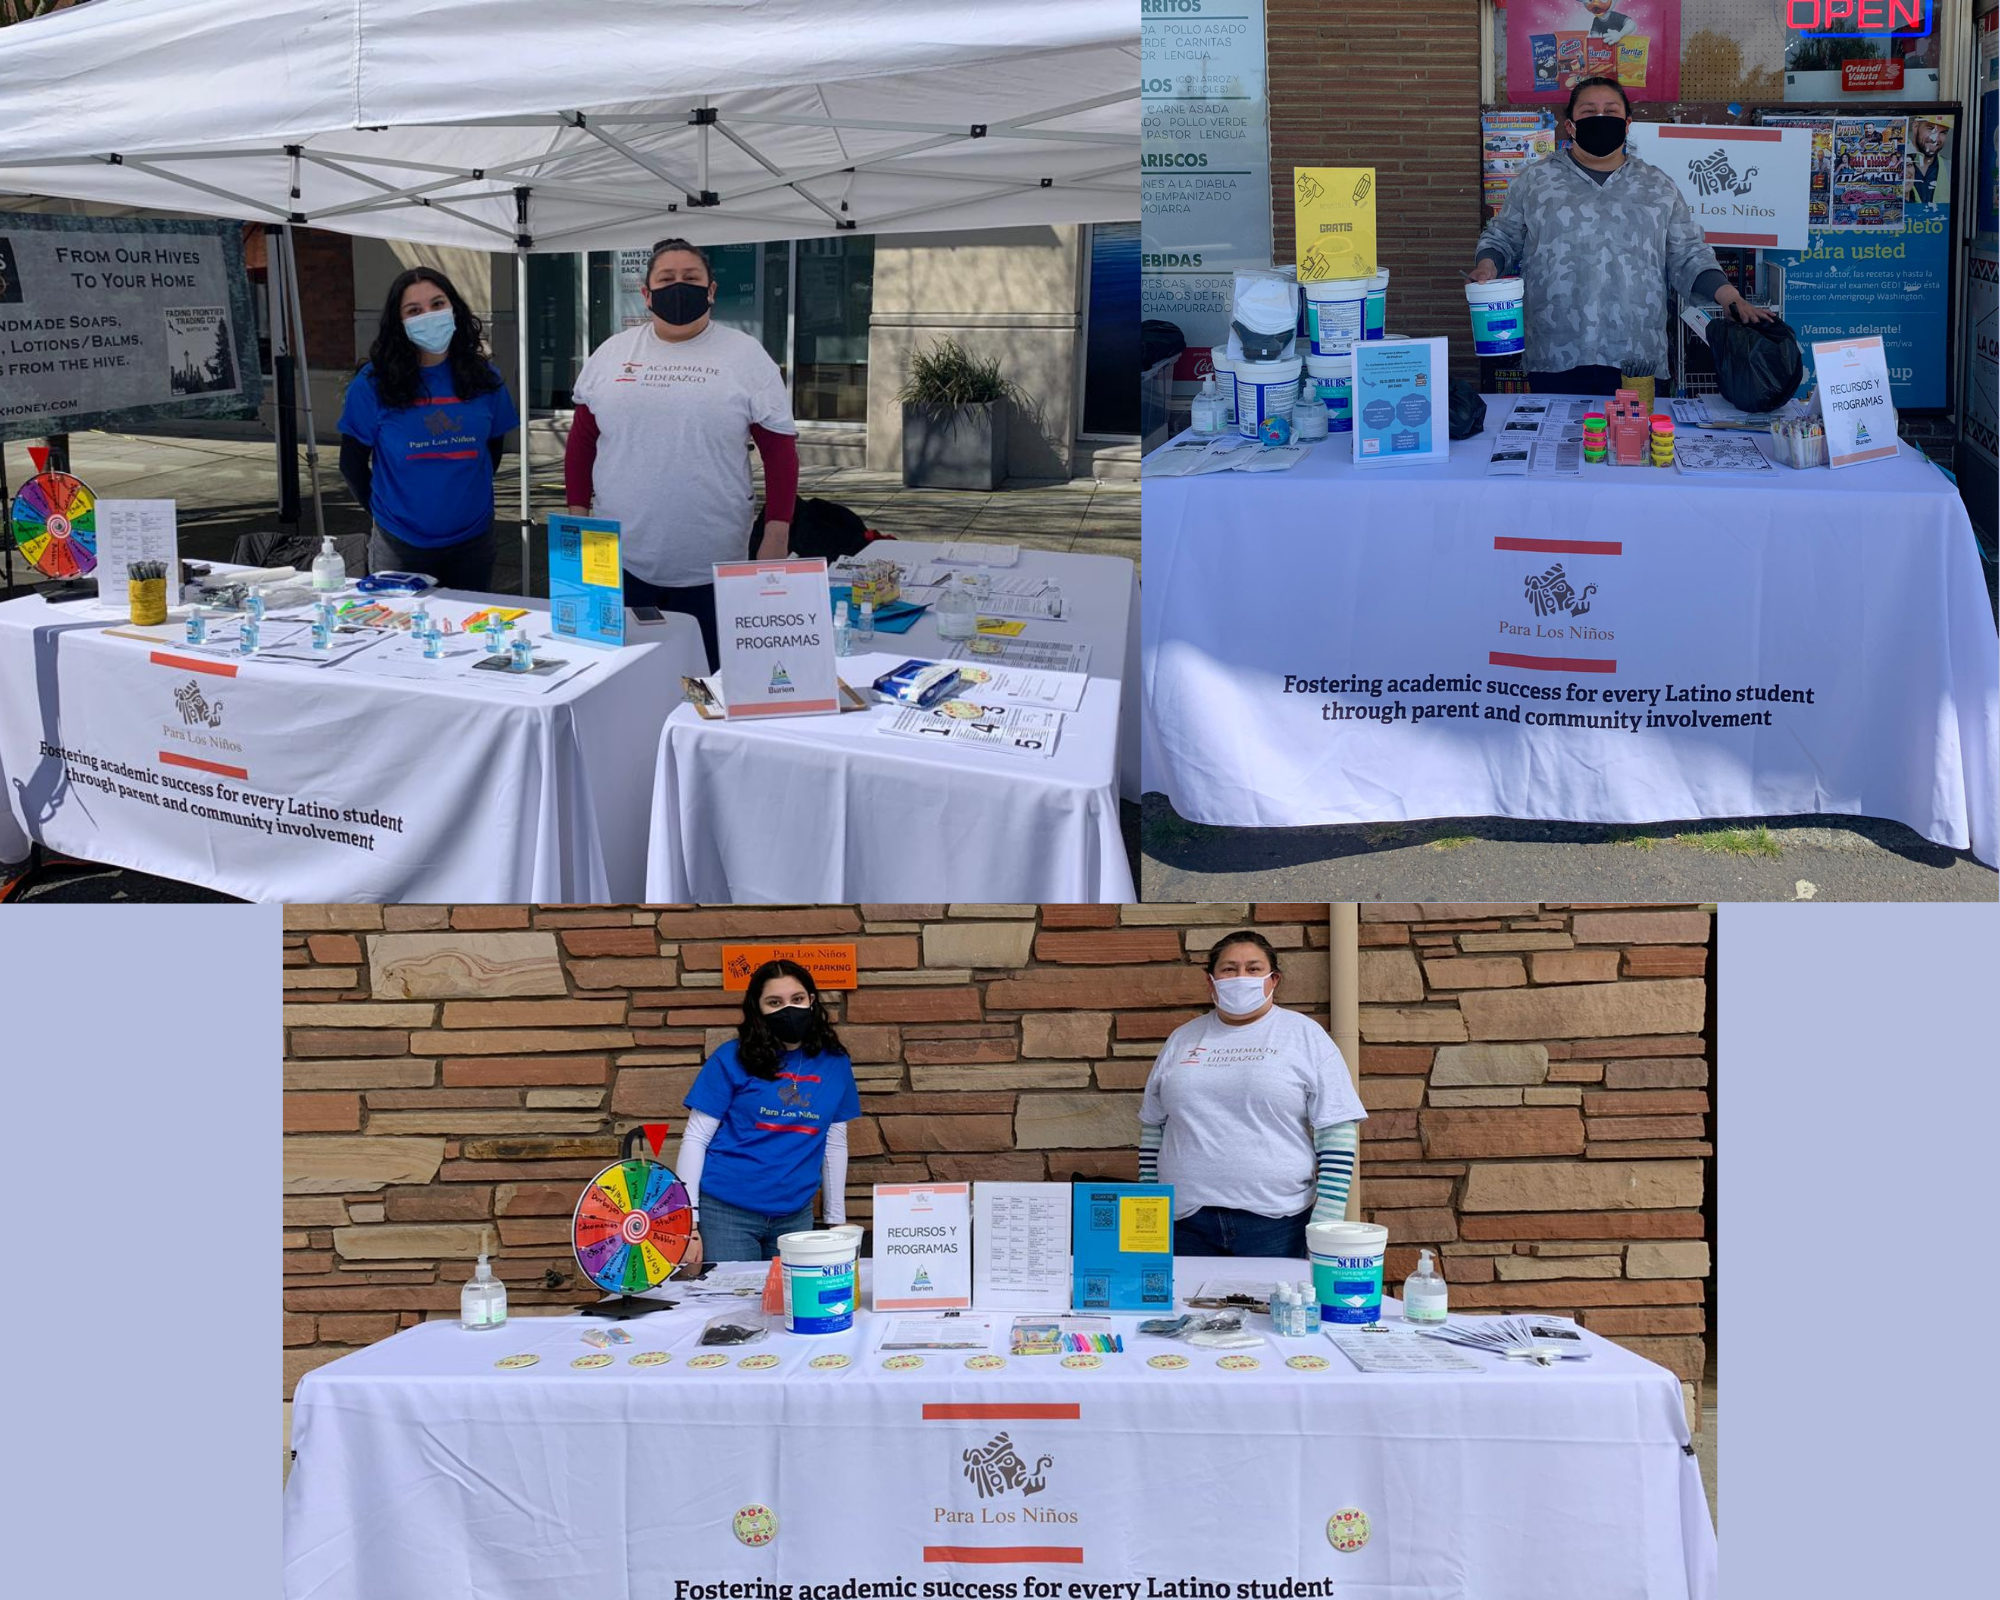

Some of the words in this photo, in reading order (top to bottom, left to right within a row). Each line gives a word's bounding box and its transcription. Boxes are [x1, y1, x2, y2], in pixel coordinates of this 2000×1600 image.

[1786, 0, 1920, 29] OPEN
[1164, 25, 1201, 34] POLLO
[1205, 25, 1246, 34] ASADO
[1175, 38, 1232, 47] CARNITAS
[1164, 51, 1211, 60] LENGUA
[1589, 50, 1611, 58] Barritas
[1621, 47, 1643, 57] Barritas
[1845, 64, 1882, 74] Orlandi
[1176, 75, 1199, 83] (CON
[1201, 75, 1232, 83] ARROZ
[1848, 72, 1879, 82] Valuta
[1147, 105, 1186, 114] CARNE
[1189, 105, 1230, 114] ASADA
[1170, 118, 1207, 127] POLLO
[1210, 118, 1247, 127] VERDE
[1147, 130, 1191, 140] PASTOR
[1200, 130, 1246, 139] LENGUA
[1168, 180, 1176, 188] A
[1179, 180, 1192, 188] LA
[1196, 180, 1237, 188] DIABLA
[1156, 192, 1232, 200] EMPANIZADO
[1700, 204, 1726, 215] Los
[1732, 204, 1775, 218] Niños
[1320, 223, 1352, 233] GRATIS
[56, 248, 110, 264] FROM
[116, 248, 151, 264] OUR
[156, 250, 200, 264] HIVES
[1800, 246, 1844, 262] para
[1851, 243, 1906, 259] usted
[71, 272, 97, 289] TO
[102, 272, 146, 288] YOUR
[152, 272, 196, 288] HOME
[1815, 270, 1822, 278] al
[1854, 270, 1864, 278] las
[1896, 272, 1900, 280] y
[1902, 270, 1924, 278] hasta
[1926, 270, 1932, 278] la
[1924, 280, 1940, 288] está
[1194, 292, 1208, 300] DE
[1828, 292, 1875, 302] Amerigroup
[1876, 292, 1926, 302] Washington.
[1488, 300, 1514, 311] SCRUBS
[166, 310, 192, 318] FADING
[192, 308, 225, 317] FRONTIER
[70, 316, 122, 329] SOAPS,
[1801, 325, 1844, 336] ¡Vamos,
[1848, 324, 1901, 334] adelante!
[1978, 334, 1987, 353] LA
[9, 361, 54, 376] FROM
[59, 358, 90, 372] THE
[93, 355, 130, 370] HIVE.
[706, 367, 720, 376] DE
[644, 374, 706, 383] LIDERAZGO
[1317, 378, 1346, 388] SCRUBS
[1830, 380, 1872, 396] RECURSOS
[1874, 379, 1880, 388] Y
[1832, 395, 1884, 412] PROGRAMAS
[410, 440, 429, 448] Para
[450, 436, 476, 444] Niños
[1856, 438, 1872, 446] Burien
[735, 614, 805, 628] RECURSOS
[808, 613, 816, 624] Y
[1499, 621, 1532, 636] Para
[1536, 624, 1564, 639] Los
[1569, 625, 1615, 642] Niños
[736, 634, 820, 650] PROGRAMAS
[768, 686, 794, 694] Burien
[1284, 675, 1384, 700] Fostering
[1387, 674, 1482, 694] academic
[1486, 680, 1562, 701] success
[1566, 683, 1598, 703] for
[1602, 687, 1660, 708] every
[1665, 683, 1732, 703] Latino
[1736, 682, 1815, 705] student
[1322, 701, 1407, 726] through
[1411, 701, 1480, 723] parent
[1484, 702, 1521, 723] and
[1525, 707, 1643, 734] community
[1646, 708, 1773, 730] involvement
[162, 725, 186, 740] Para
[188, 730, 206, 747] Los
[209, 732, 242, 753] Niños
[40, 740, 98, 771] Fostering
[100, 758, 159, 785] academic
[162, 776, 214, 798] success
[216, 782, 239, 802] for
[242, 790, 284, 815] every
[288, 797, 340, 821] Latino
[343, 805, 403, 834] student
[65, 767, 116, 796] through
[118, 782, 160, 808] parent
[162, 794, 188, 814] and
[190, 804, 274, 834] community
[276, 818, 374, 851] involvement
[773, 950, 794, 959] Para
[798, 950, 815, 959] Los
[818, 949, 846, 959] Niños
[1266, 1048, 1279, 1056] DE
[760, 1106, 779, 1116] Para
[782, 1110, 796, 1118] Los
[798, 1110, 820, 1120] Niños
[888, 1227, 946, 1238] RECURSOS
[950, 1226, 957, 1236] Y
[653, 1232, 676, 1246] Bubbles
[887, 1243, 958, 1255] PROGRAMAS
[1337, 1257, 1374, 1268] SCRUBS
[822, 1262, 852, 1277] SCRUBS
[934, 1508, 974, 1524] Para
[982, 1508, 1016, 1524] Los
[1022, 1506, 1078, 1524] Niños
[674, 1578, 793, 1600] Fostering
[798, 1577, 917, 1600] academic
[923, 1579, 1017, 1599] success
[1023, 1576, 1062, 1598] for
[1068, 1581, 1141, 1600] every
[1147, 1578, 1230, 1598] Latino
[1236, 1576, 1334, 1599] student
